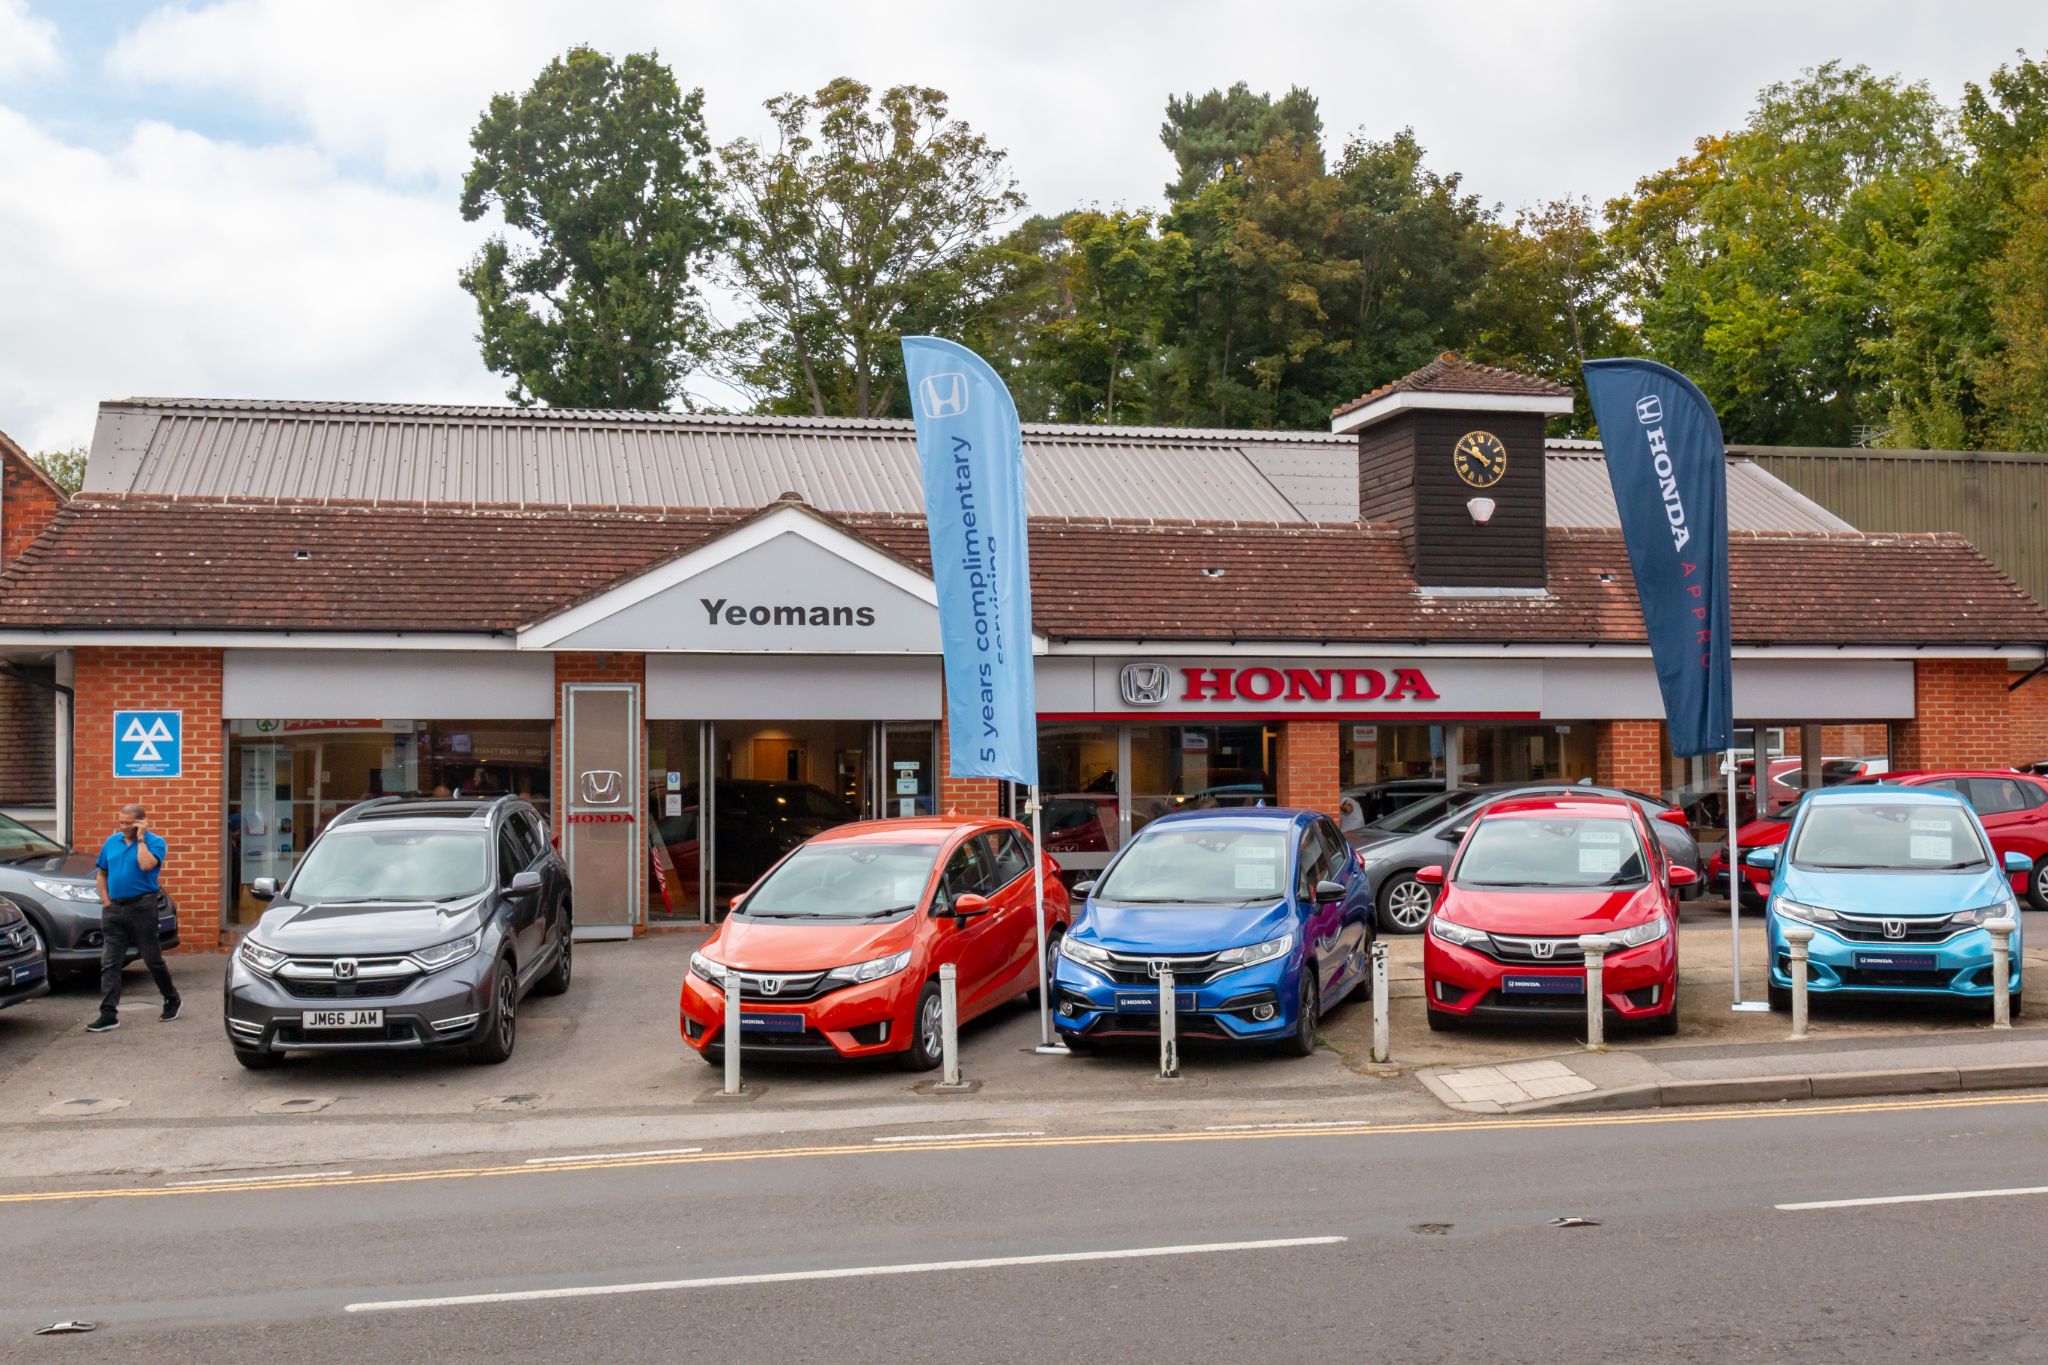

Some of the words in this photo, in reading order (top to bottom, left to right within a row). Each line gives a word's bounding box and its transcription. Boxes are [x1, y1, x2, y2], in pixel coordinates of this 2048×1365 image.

[1646, 426, 1690, 553] HONDA
[951, 436, 989, 652] complimentary
[700, 599, 875, 627] Yeomans
[1181, 667, 1441, 701] HONDA
[980, 663, 998, 738] years
[980, 748, 996, 763] 5
[567, 814, 636, 823] HONDA
[309, 1012, 345, 1026] JM66
[350, 1011, 377, 1025] JAM
